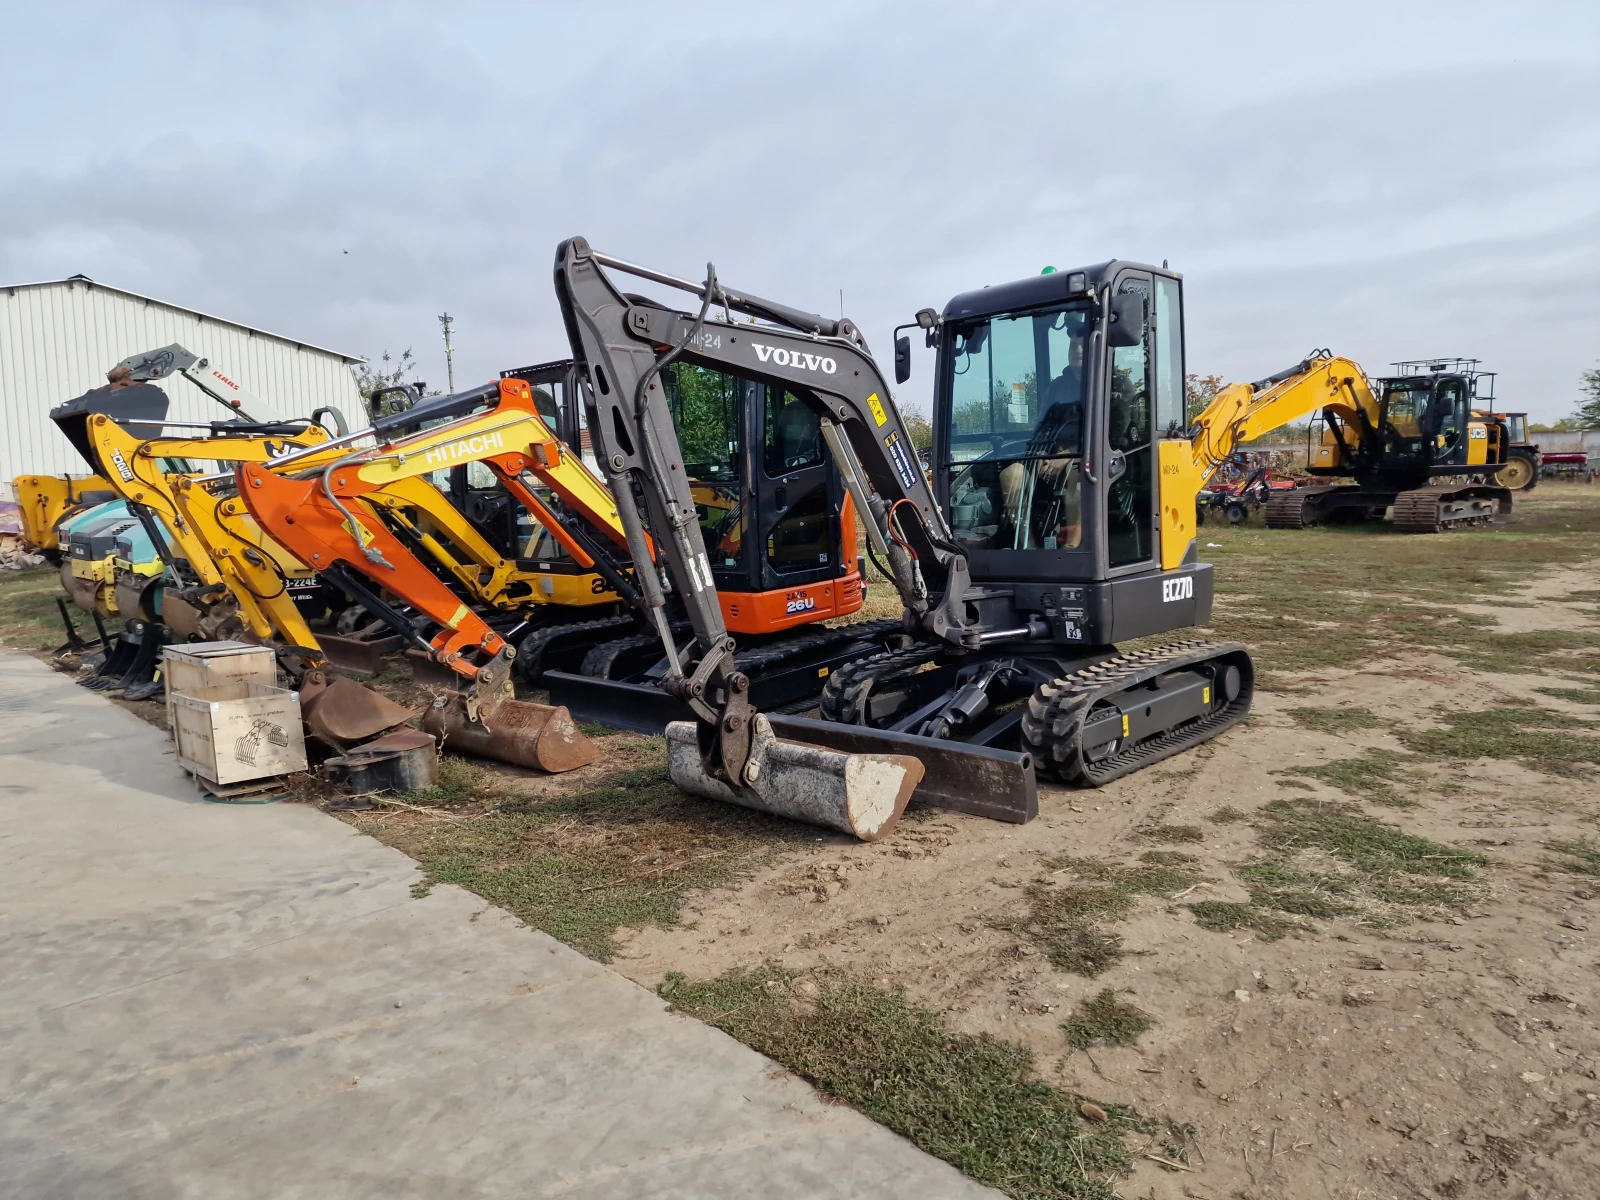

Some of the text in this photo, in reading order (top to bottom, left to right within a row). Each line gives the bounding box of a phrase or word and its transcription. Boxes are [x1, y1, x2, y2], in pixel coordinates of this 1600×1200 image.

[752, 343, 837, 374] VOLVO
[212, 370, 240, 391] CLAAS
[1470, 428, 1486, 439] JCB
[425, 432, 504, 464] HITACHI
[1162, 576, 1193, 603] EC27D
[786, 597, 814, 613] 26U
